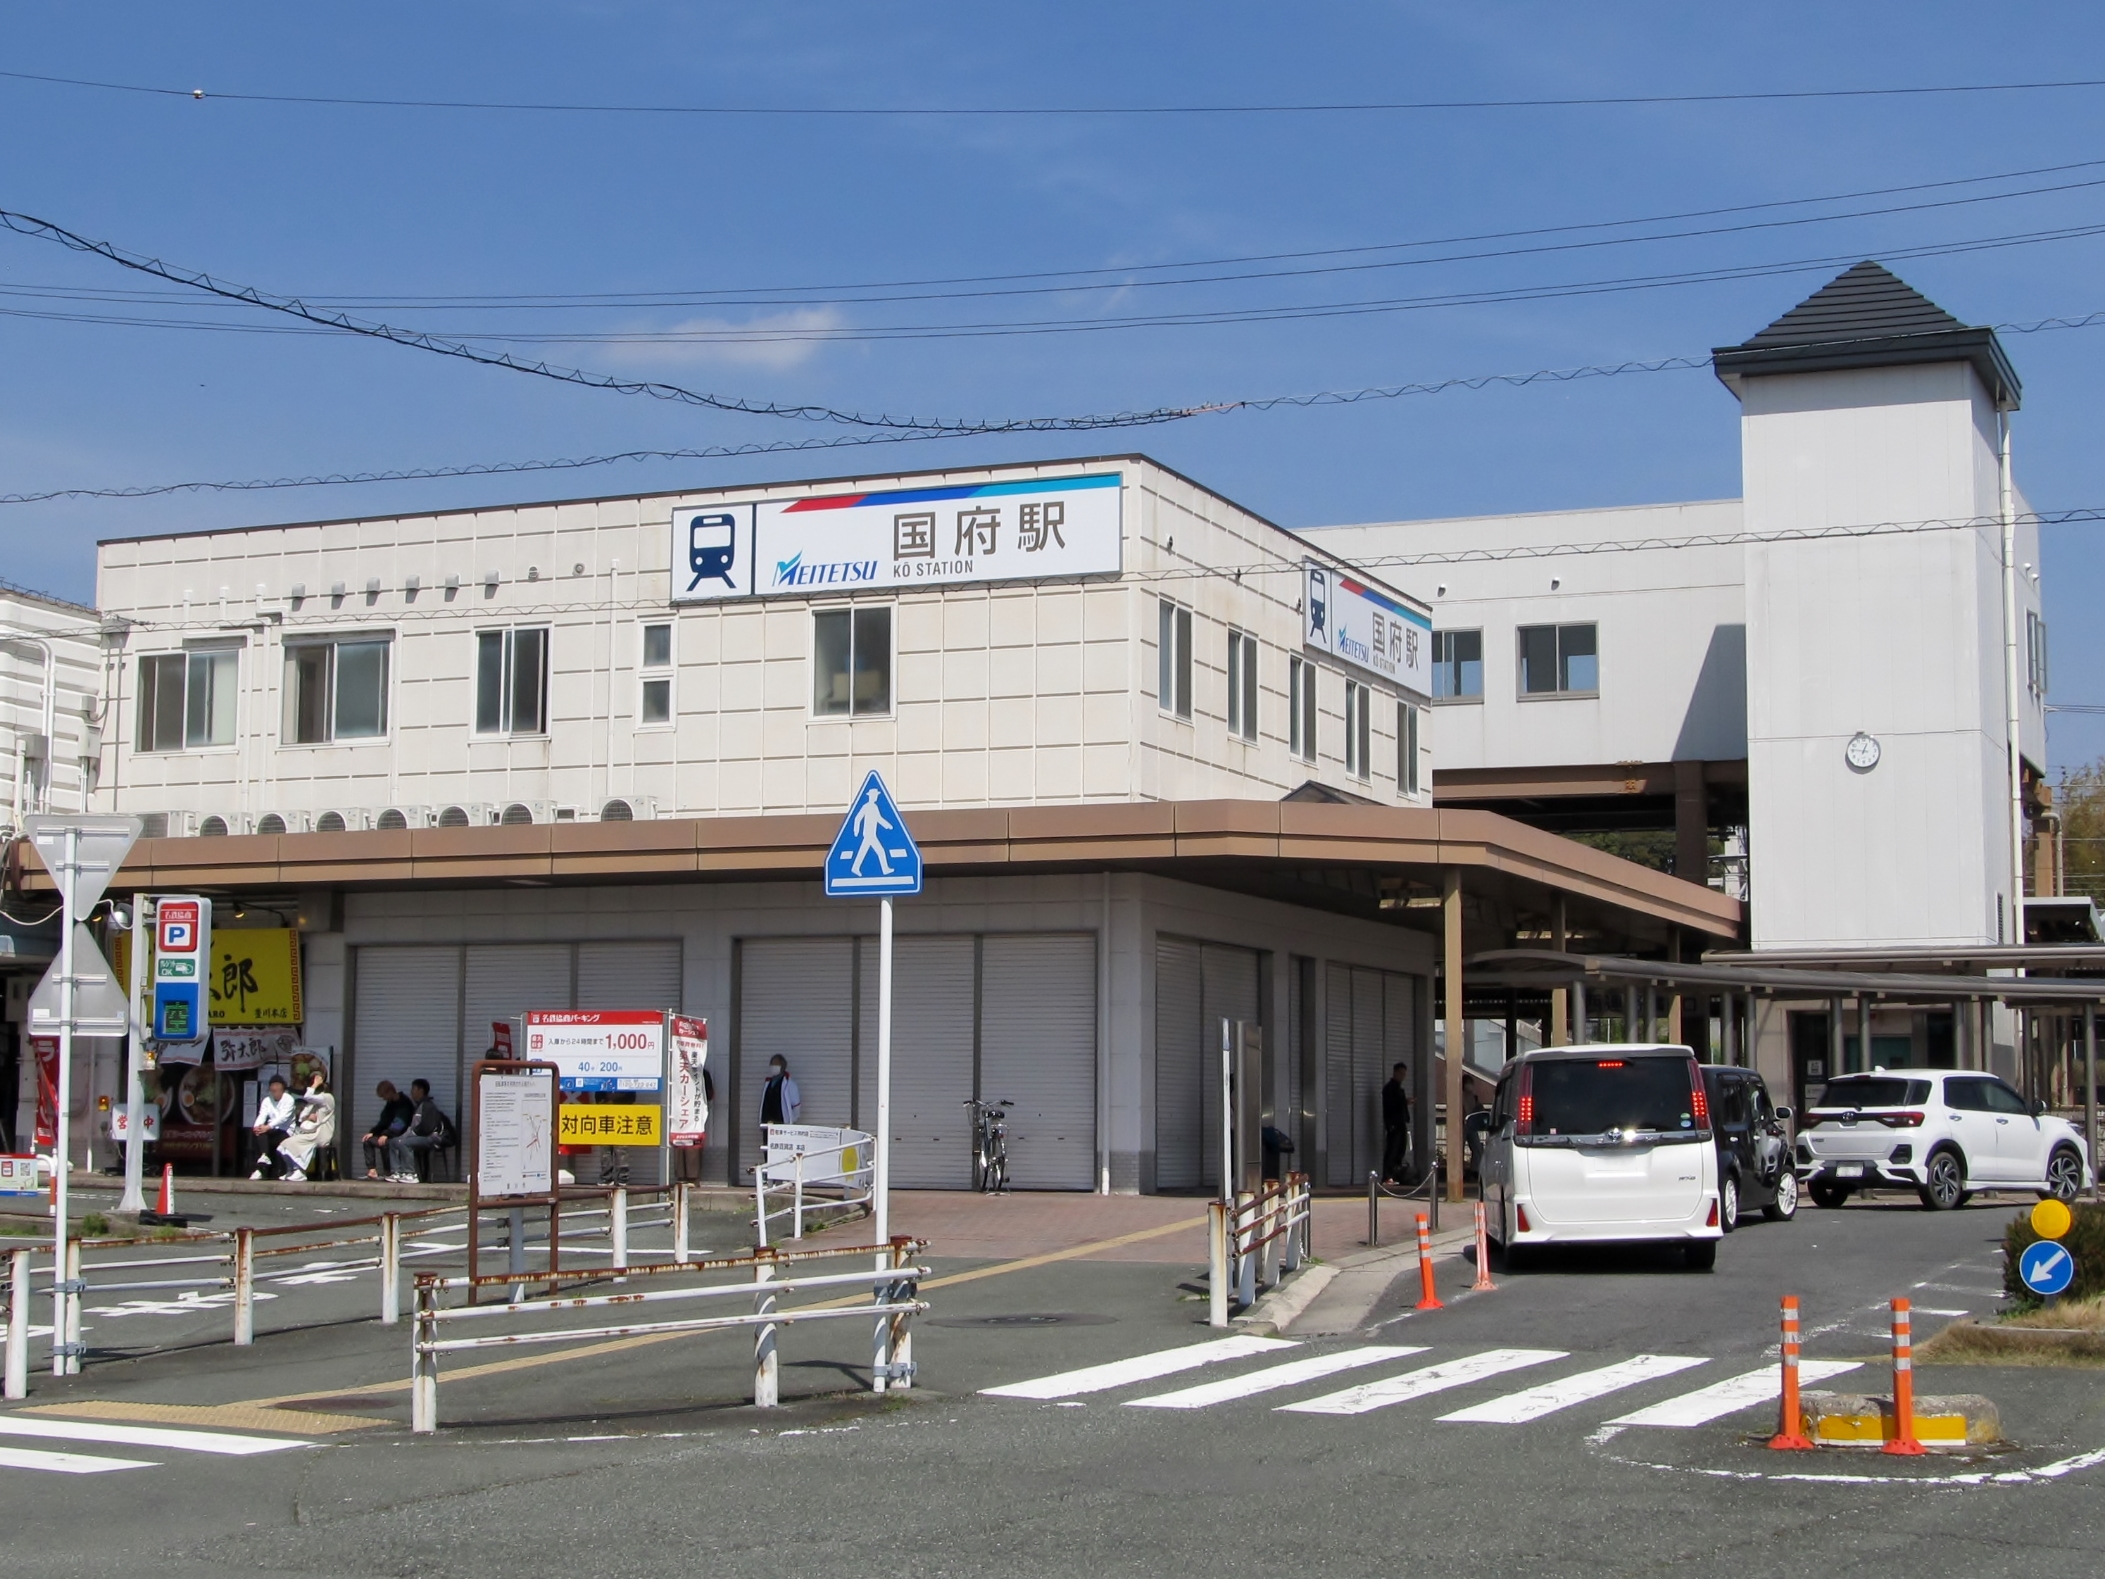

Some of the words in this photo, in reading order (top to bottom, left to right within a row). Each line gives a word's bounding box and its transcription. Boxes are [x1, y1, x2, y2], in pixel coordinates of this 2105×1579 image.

[893, 500, 1066, 561] 国府駅
[771, 547, 878, 586] MEITETSU
[916, 558, 973, 577] STATION
[1338, 622, 1369, 663] MEITETSU
[1372, 611, 1419, 671] 国府駅
[168, 926, 185, 943] P
[161, 968, 173, 976] OK
[220, 1038, 267, 1063] 弥太郎
[548, 1038, 604, 1046] 入庫から24時間まで
[605, 1033, 655, 1050] 1,000円
[117, 1115, 154, 1130] 営中
[561, 1114, 653, 1135] 対向車注意
